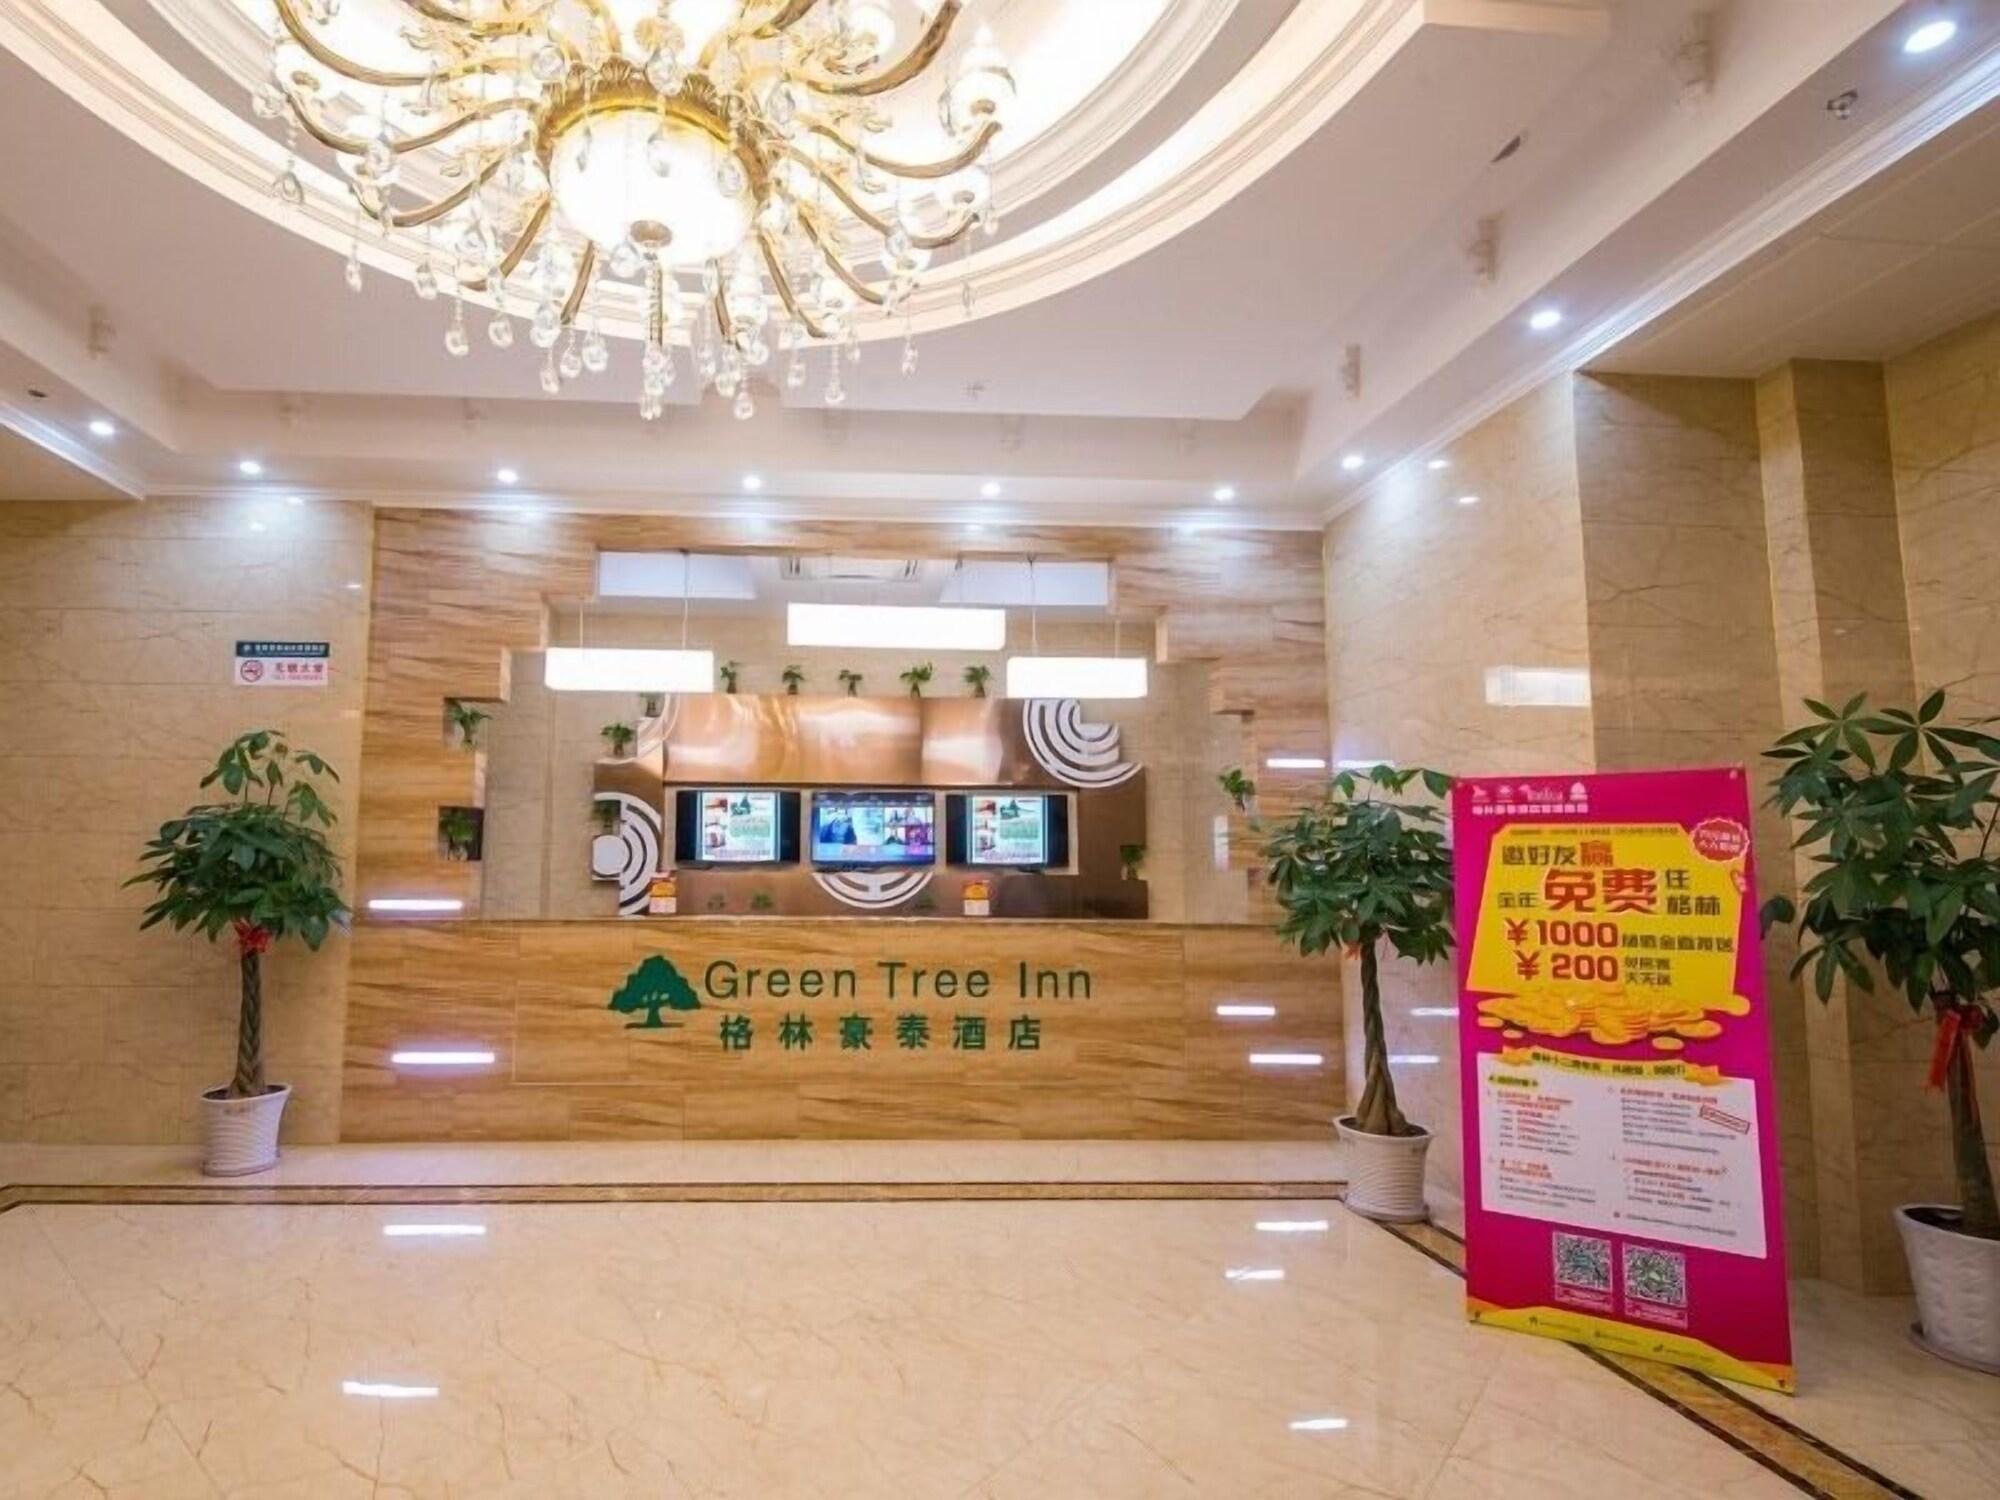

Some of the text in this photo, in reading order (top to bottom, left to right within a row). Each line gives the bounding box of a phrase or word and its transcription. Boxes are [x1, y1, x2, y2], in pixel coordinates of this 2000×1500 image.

[1545, 868, 1657, 913] 免费
[704, 960, 1092, 998] Green Tree Inn
[719, 1013, 1042, 1051] 格林豪泰酒店
